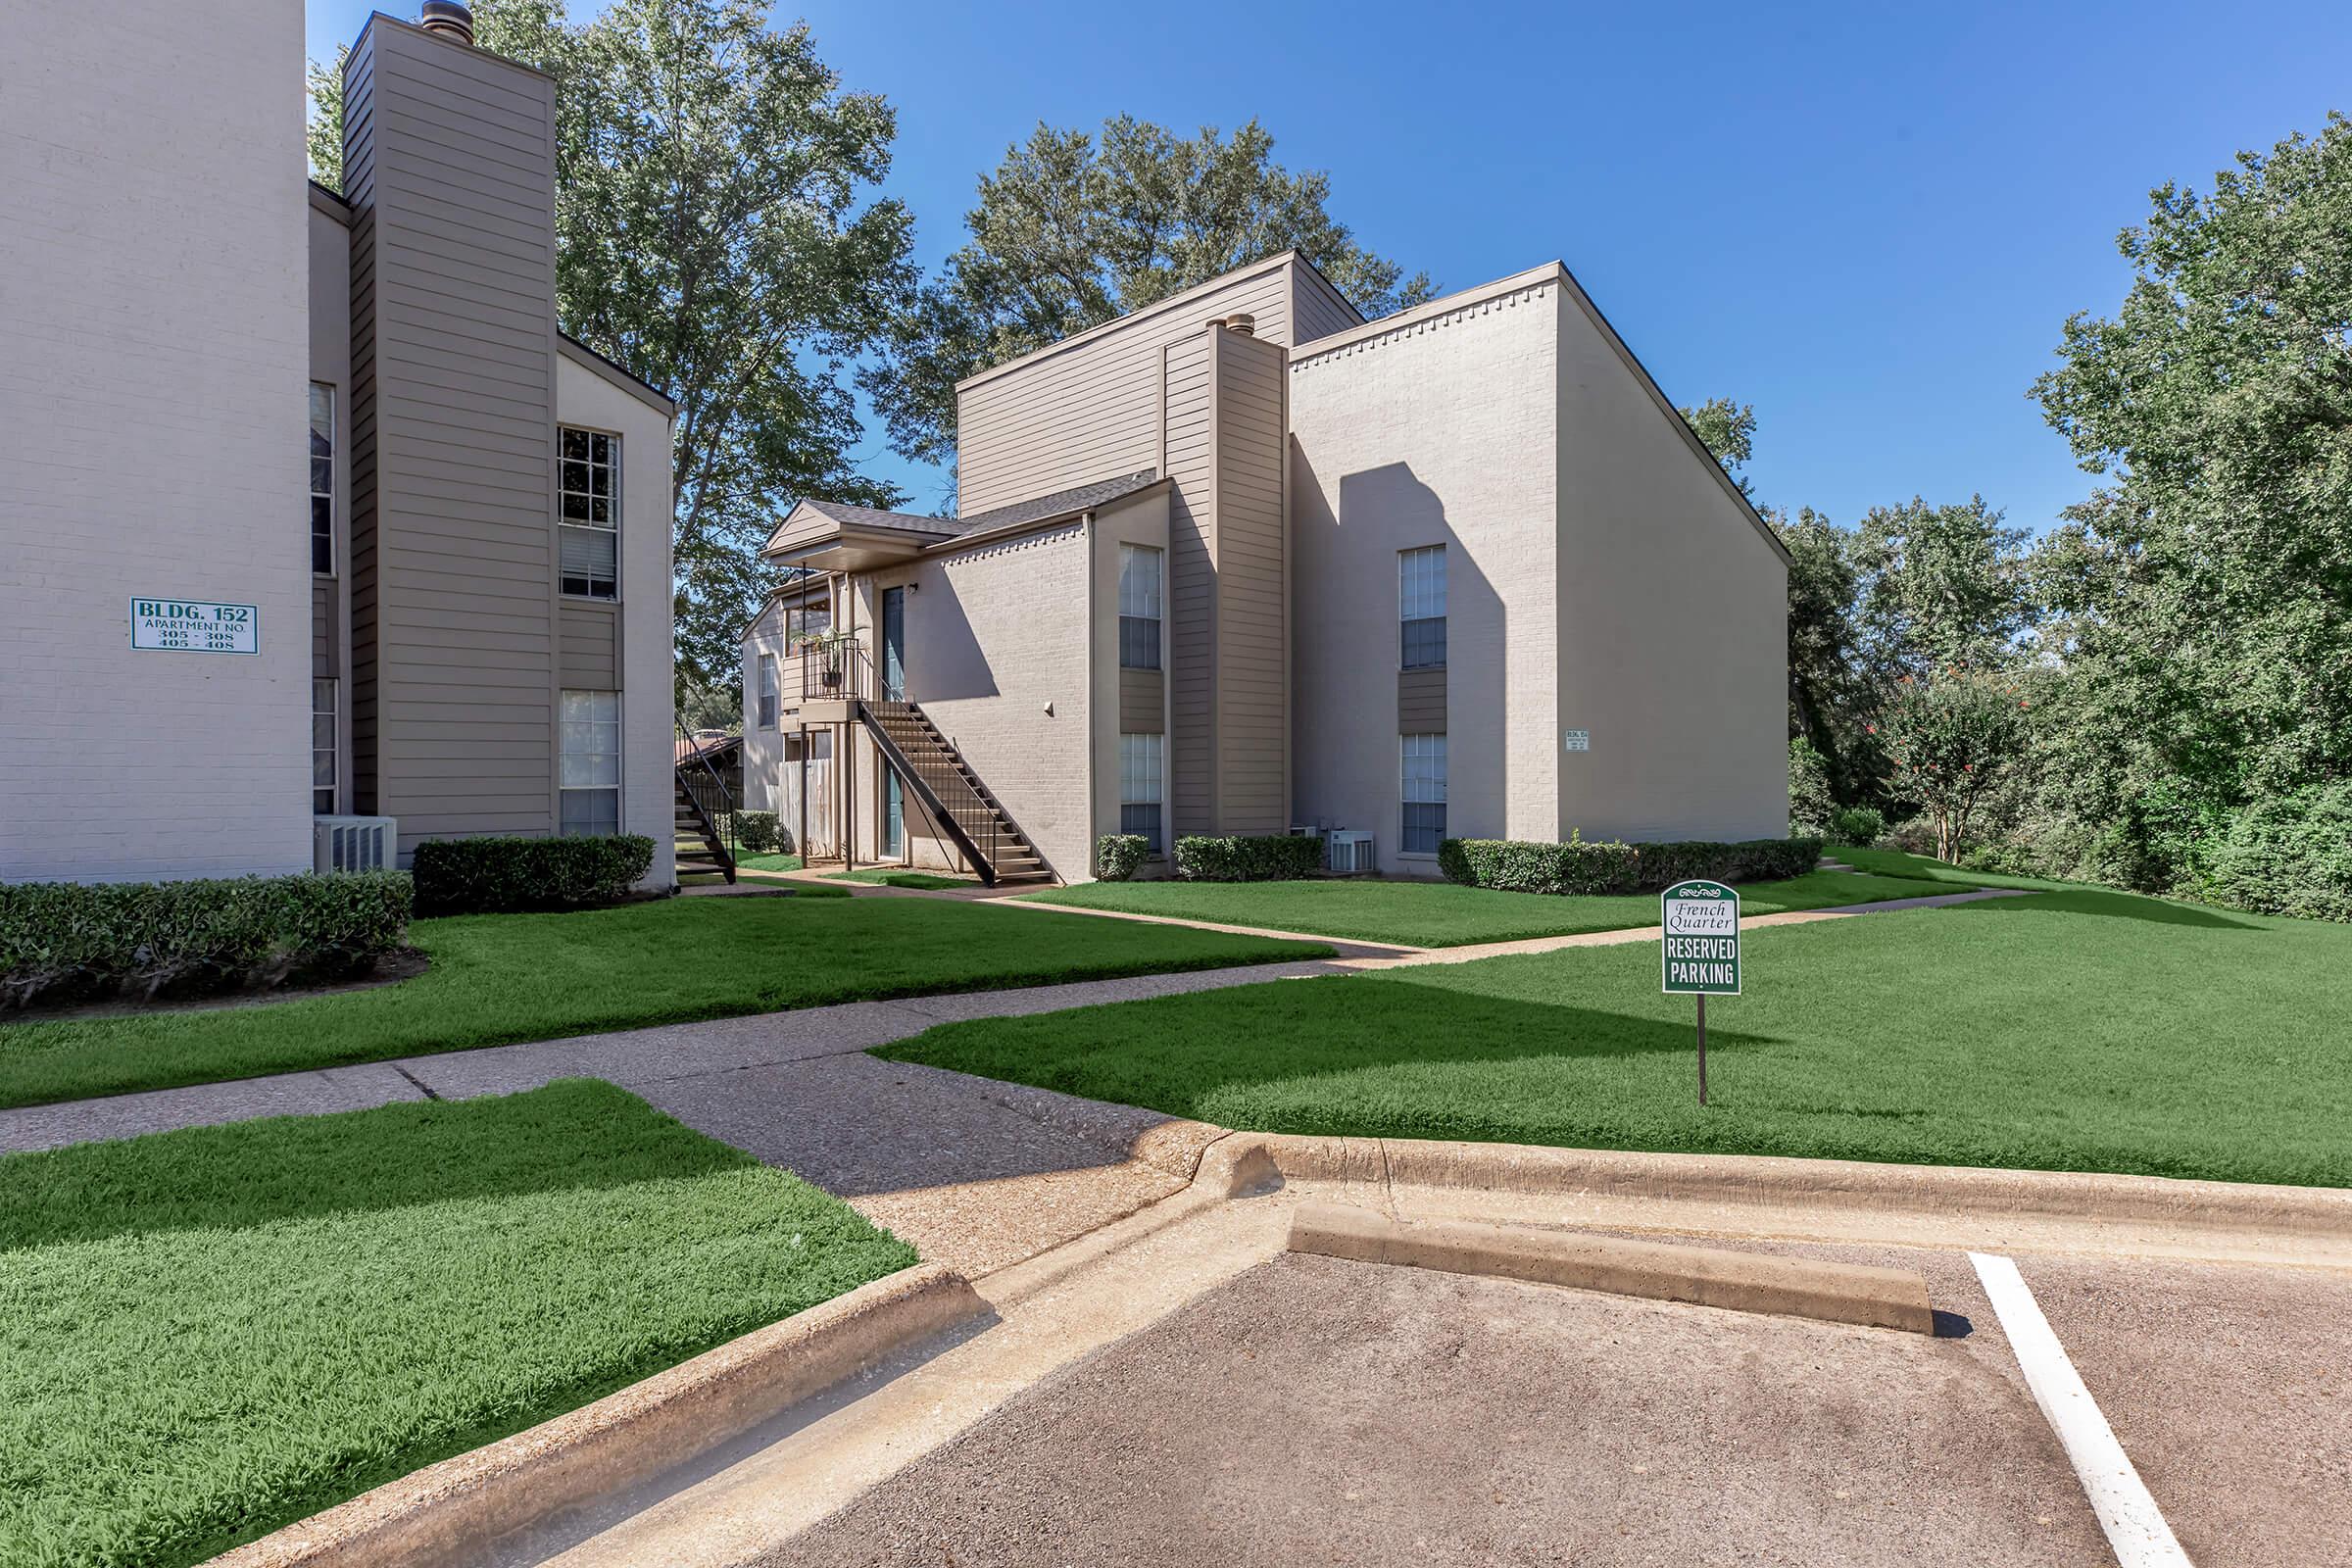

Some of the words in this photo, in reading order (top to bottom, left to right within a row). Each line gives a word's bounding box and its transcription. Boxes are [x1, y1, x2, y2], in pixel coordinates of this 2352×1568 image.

[139, 602, 205, 619] BLDG.
[214, 608, 248, 622] 152
[145, 619, 220, 631] APARTMENT
[225, 623, 246, 633] NO.
[159, 630, 188, 639] 305
[159, 639, 188, 648] 405
[1676, 902, 1725, 915] French
[1670, 916, 1732, 932] Quarter
[1667, 938, 1736, 959] RESERVED
[1671, 962, 1734, 984] PARKING
